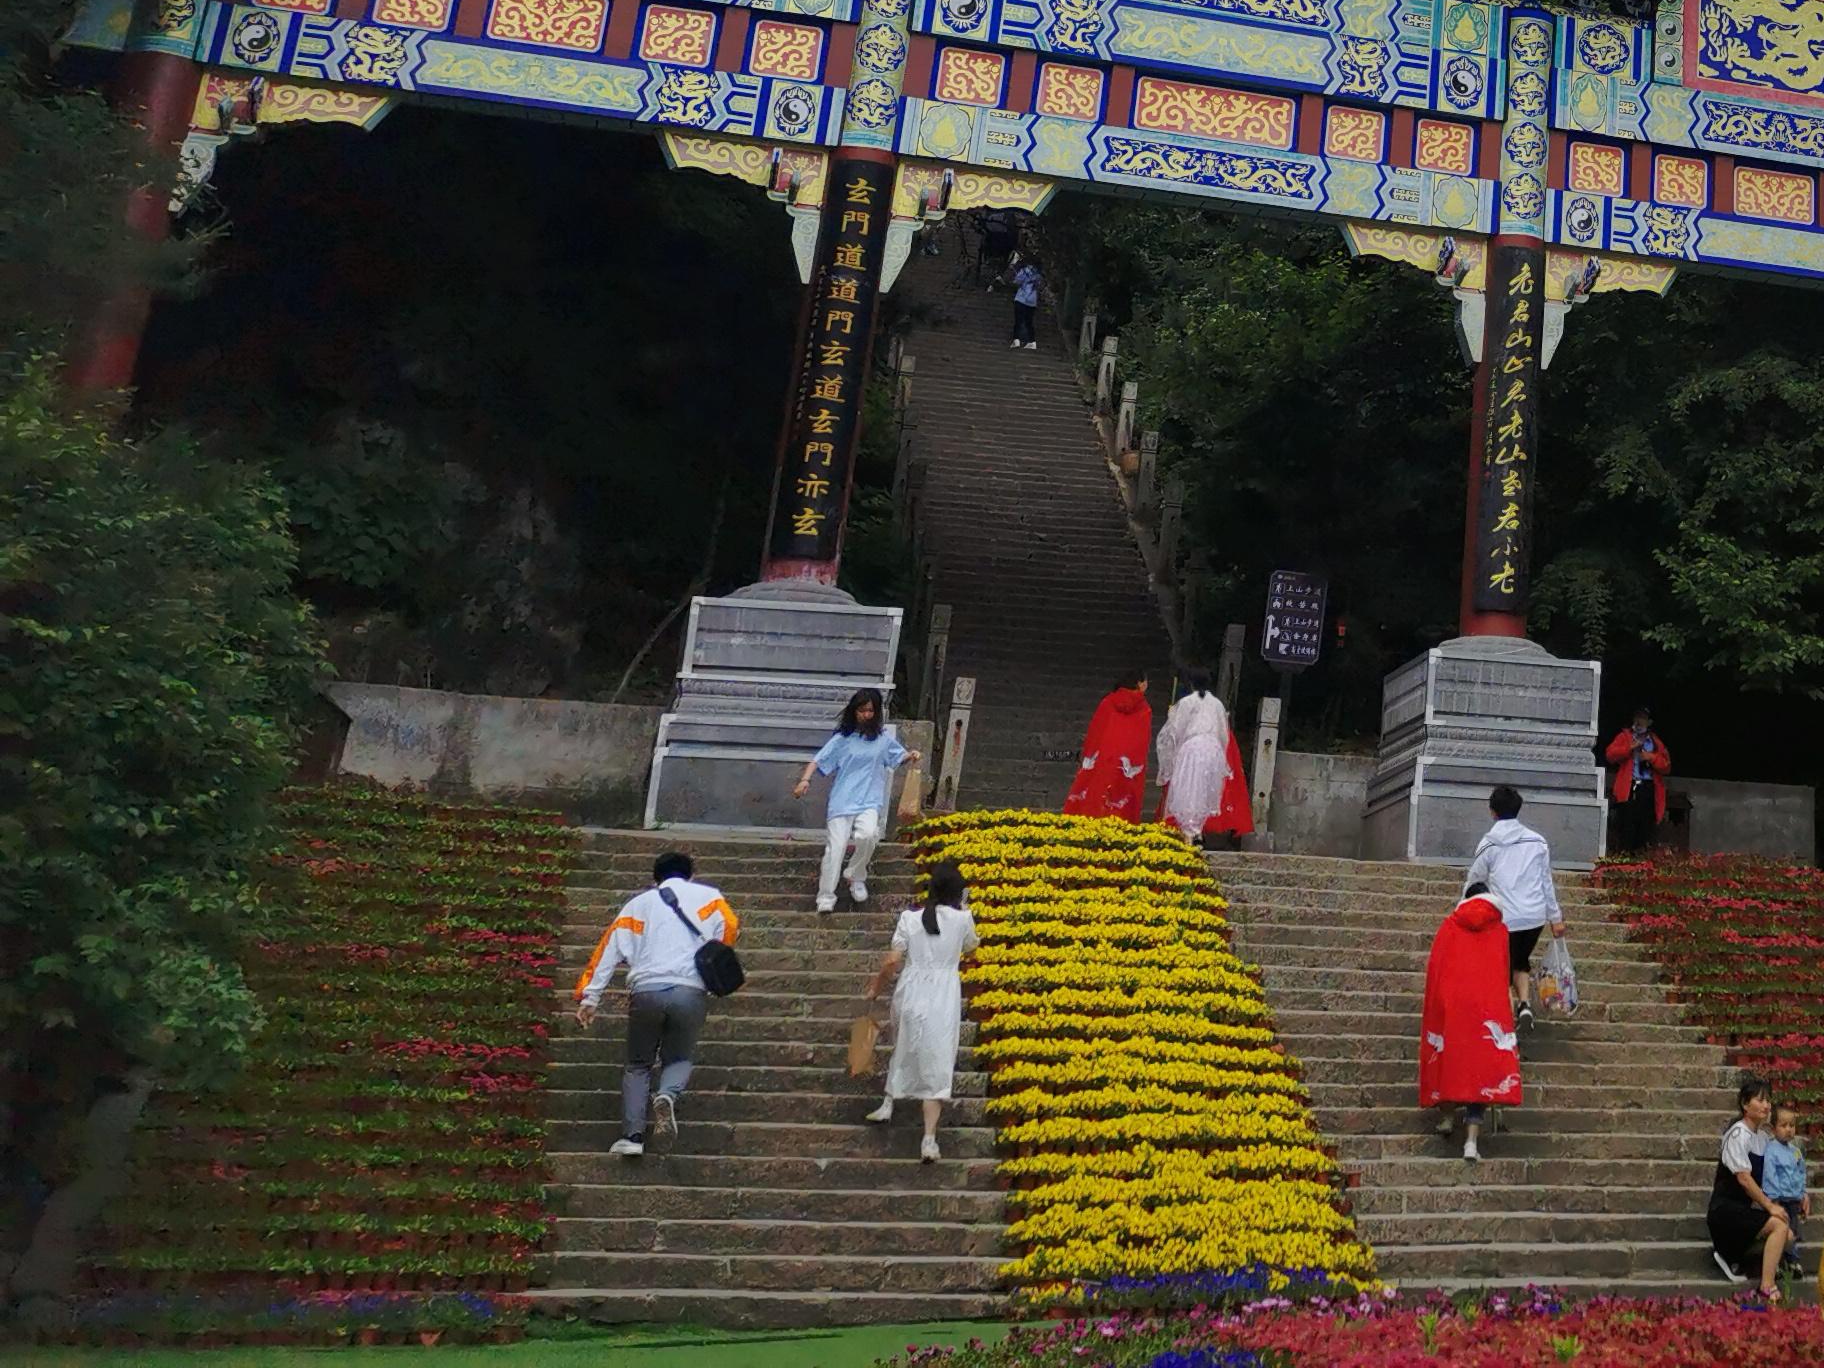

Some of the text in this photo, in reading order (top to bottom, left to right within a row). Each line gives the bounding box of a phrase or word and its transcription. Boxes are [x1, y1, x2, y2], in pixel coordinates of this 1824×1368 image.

[792, 177, 877, 537] 玄門道道門玄道玄門亦玄
